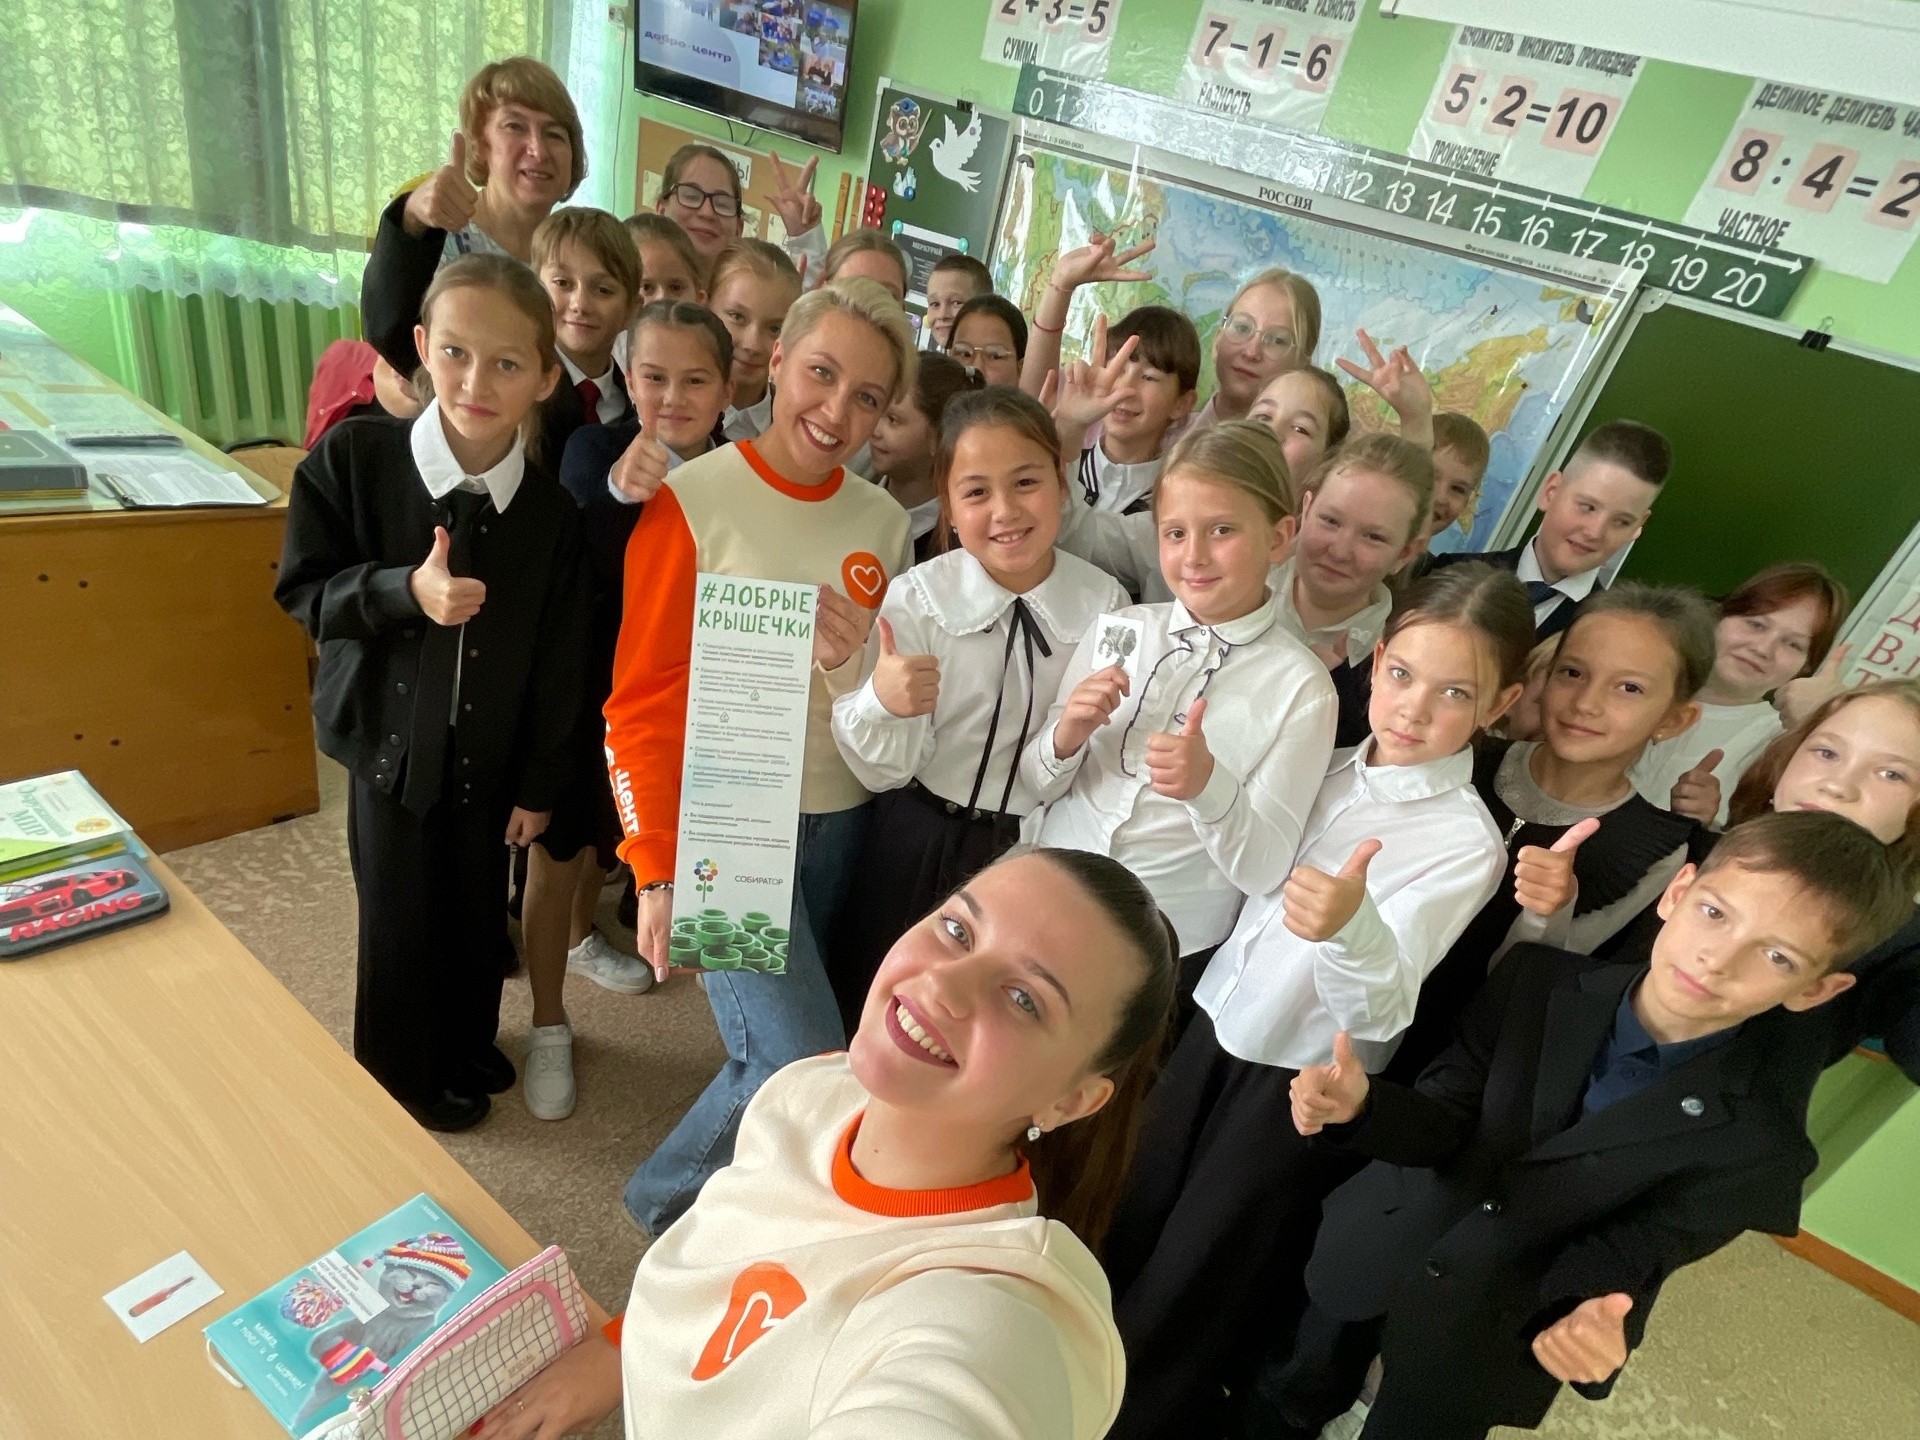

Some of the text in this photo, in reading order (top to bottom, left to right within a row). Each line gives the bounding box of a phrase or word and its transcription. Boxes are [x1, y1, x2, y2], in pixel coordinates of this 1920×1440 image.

[1003, 37, 1038, 63] СУММА
[1197, 83, 1250, 113] РАЗНОСТЬ
[1753, 82, 1829, 116] ДЕЛИМОЕ
[1822, 96, 1897, 131] ДЕЛИТЕЛЬ
[1430, 140, 1500, 175] ПРОИЗВЕДЕНИЕ
[1028, 88, 1043, 115] 0
[1344, 170, 1373, 204] 12
[1386, 179, 1415, 214] 13
[1426, 190, 1456, 226] 14
[1471, 201, 1506, 238] 15
[1520, 214, 1554, 249] 16
[1571, 228, 1608, 260] 17
[1619, 239, 1656, 272] 18
[1669, 255, 1708, 292] 19
[1713, 268, 1766, 307] 20
[1259, 187, 1314, 211] РОССИЯ
[1717, 209, 1791, 247] ЧАСТНОЕ
[701, 582, 812, 613] #ДОБРЫЕ
[699, 609, 810, 639] КРЫШЕЧКИ
[735, 875, 783, 886] СОБИРАТОР
[10, 893, 142, 942] RACING
